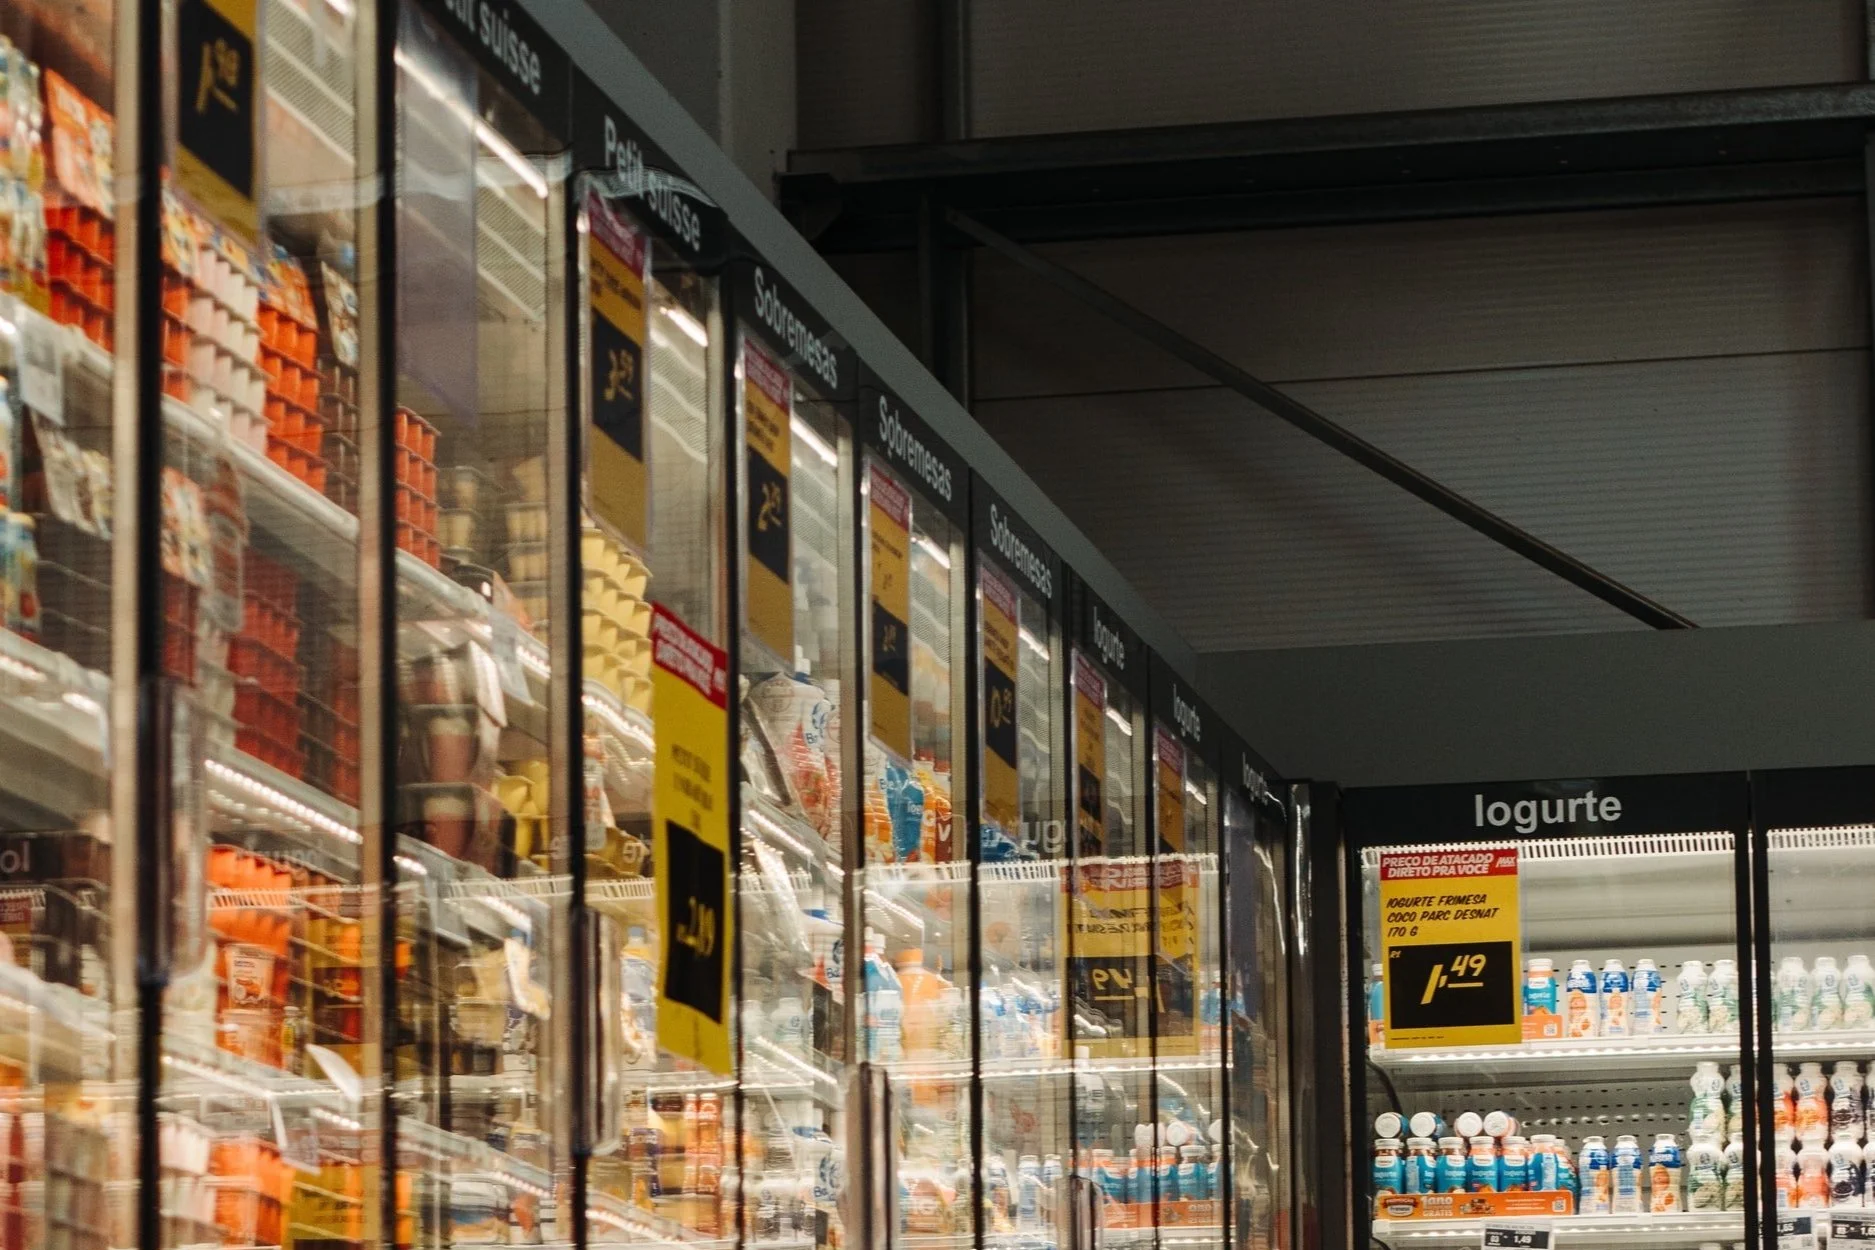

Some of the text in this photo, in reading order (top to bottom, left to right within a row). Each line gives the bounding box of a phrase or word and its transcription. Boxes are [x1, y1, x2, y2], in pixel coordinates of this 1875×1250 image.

[479, 1, 541, 95] suisse
[603, 114, 644, 200] Petit
[646, 171, 701, 252] suisse
[754, 266, 838, 390] Sobremesas
[878, 394, 952, 502] Sobremesas
[990, 503, 1052, 599] Sobremesas
[1093, 605, 1125, 671] Iogurte
[1173, 683, 1201, 743] Iogurte
[1474, 790, 1622, 834] Iogurte
[1382, 855, 1421, 870] PREÇO
[1422, 855, 1439, 867] DE
[1439, 852, 1494, 866] ATACADO
[1387, 866, 1432, 878] DIRETO
[1432, 865, 1458, 877] PRA
[1386, 894, 1487, 909] IOGURTE FRIMESA
[1387, 907, 1500, 923] COCO PARC DESNAT
[1387, 926, 1419, 938] 170 G
